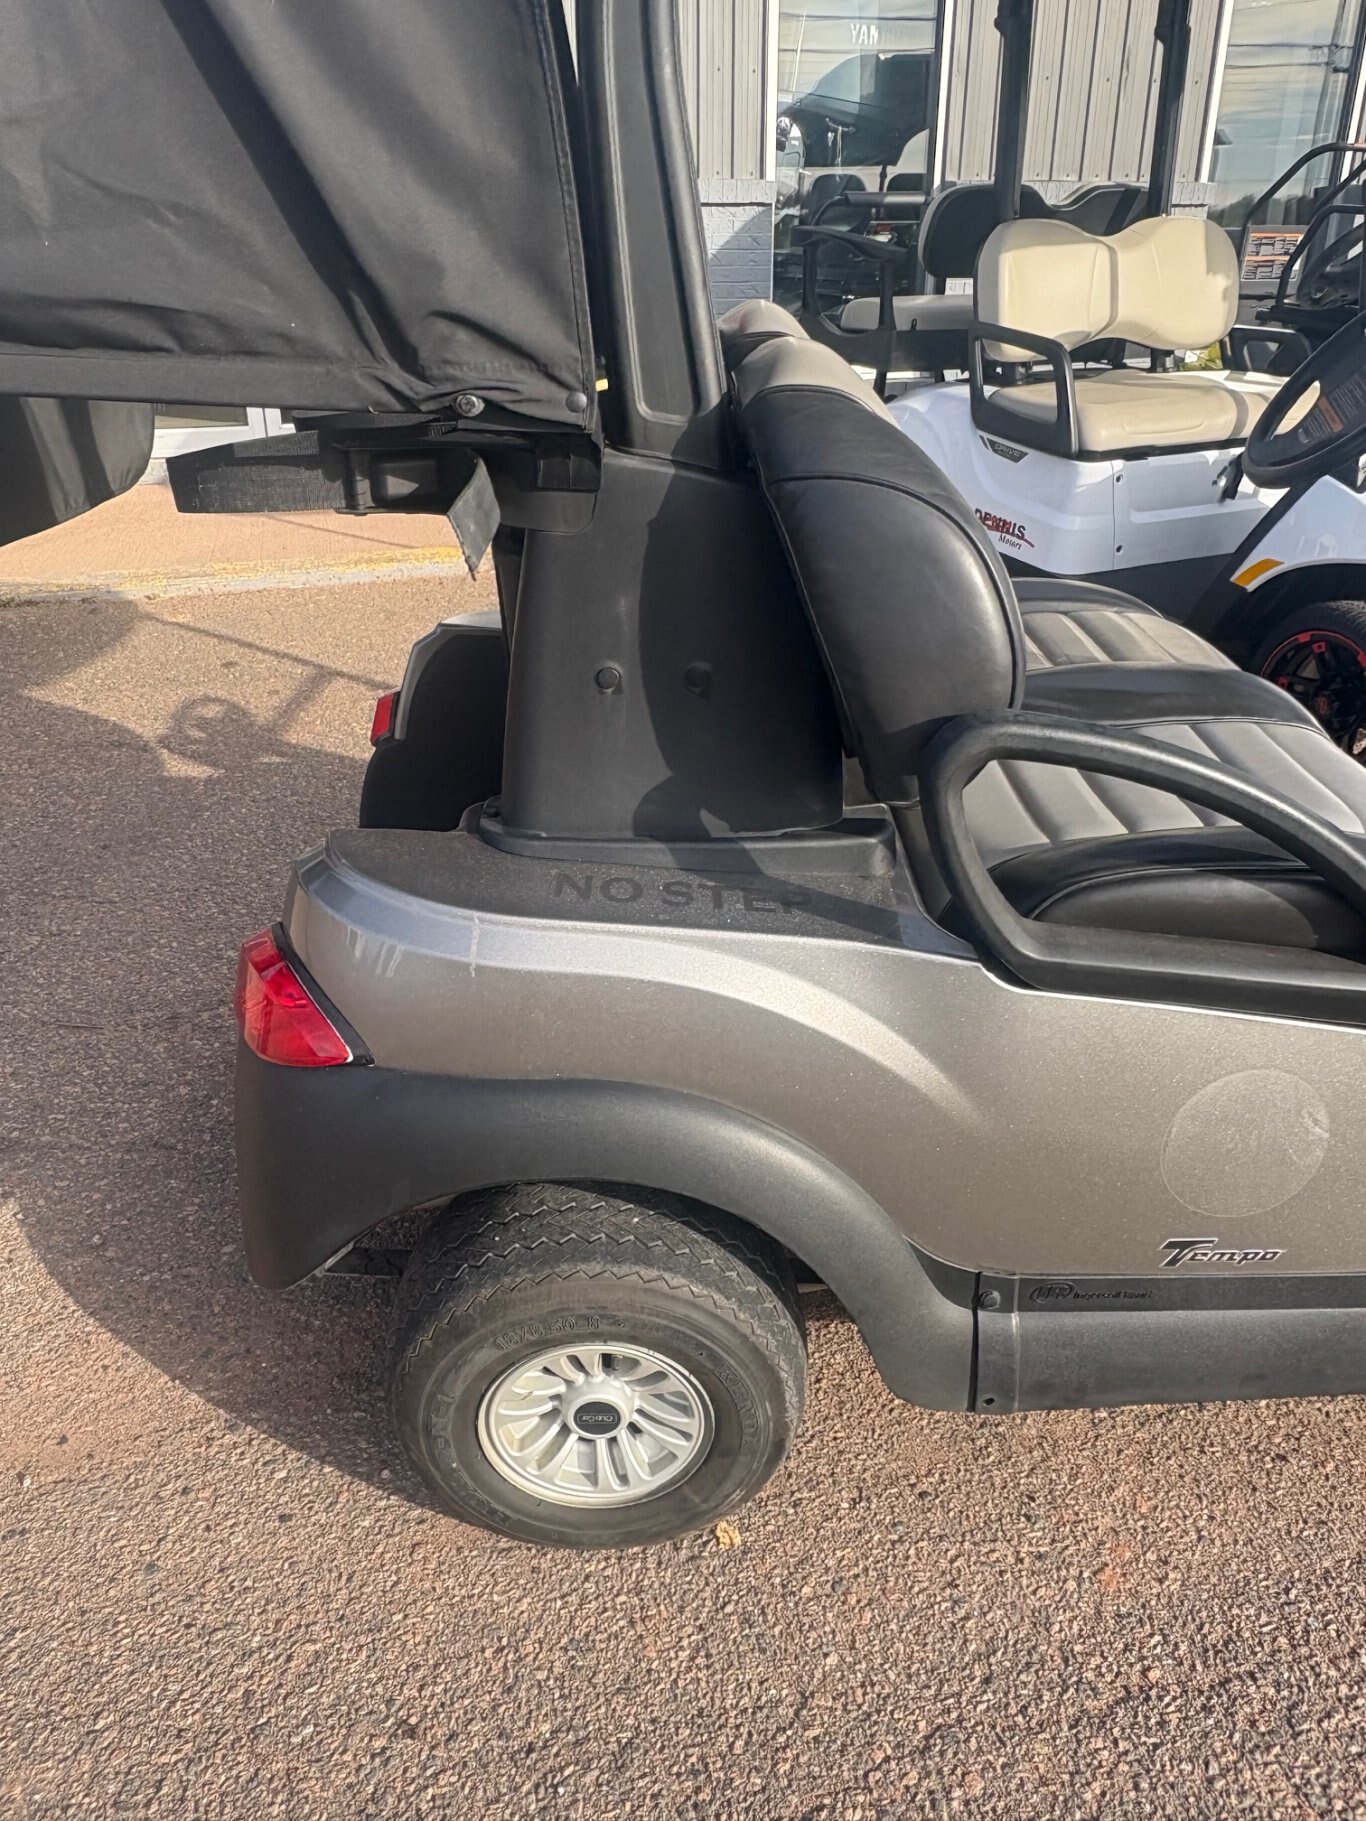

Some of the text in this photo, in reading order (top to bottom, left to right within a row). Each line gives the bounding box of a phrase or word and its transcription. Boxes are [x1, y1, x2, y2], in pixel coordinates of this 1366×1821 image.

[553, 873, 812, 915] NO STEP
[1158, 1237, 1286, 1267] Tempo
